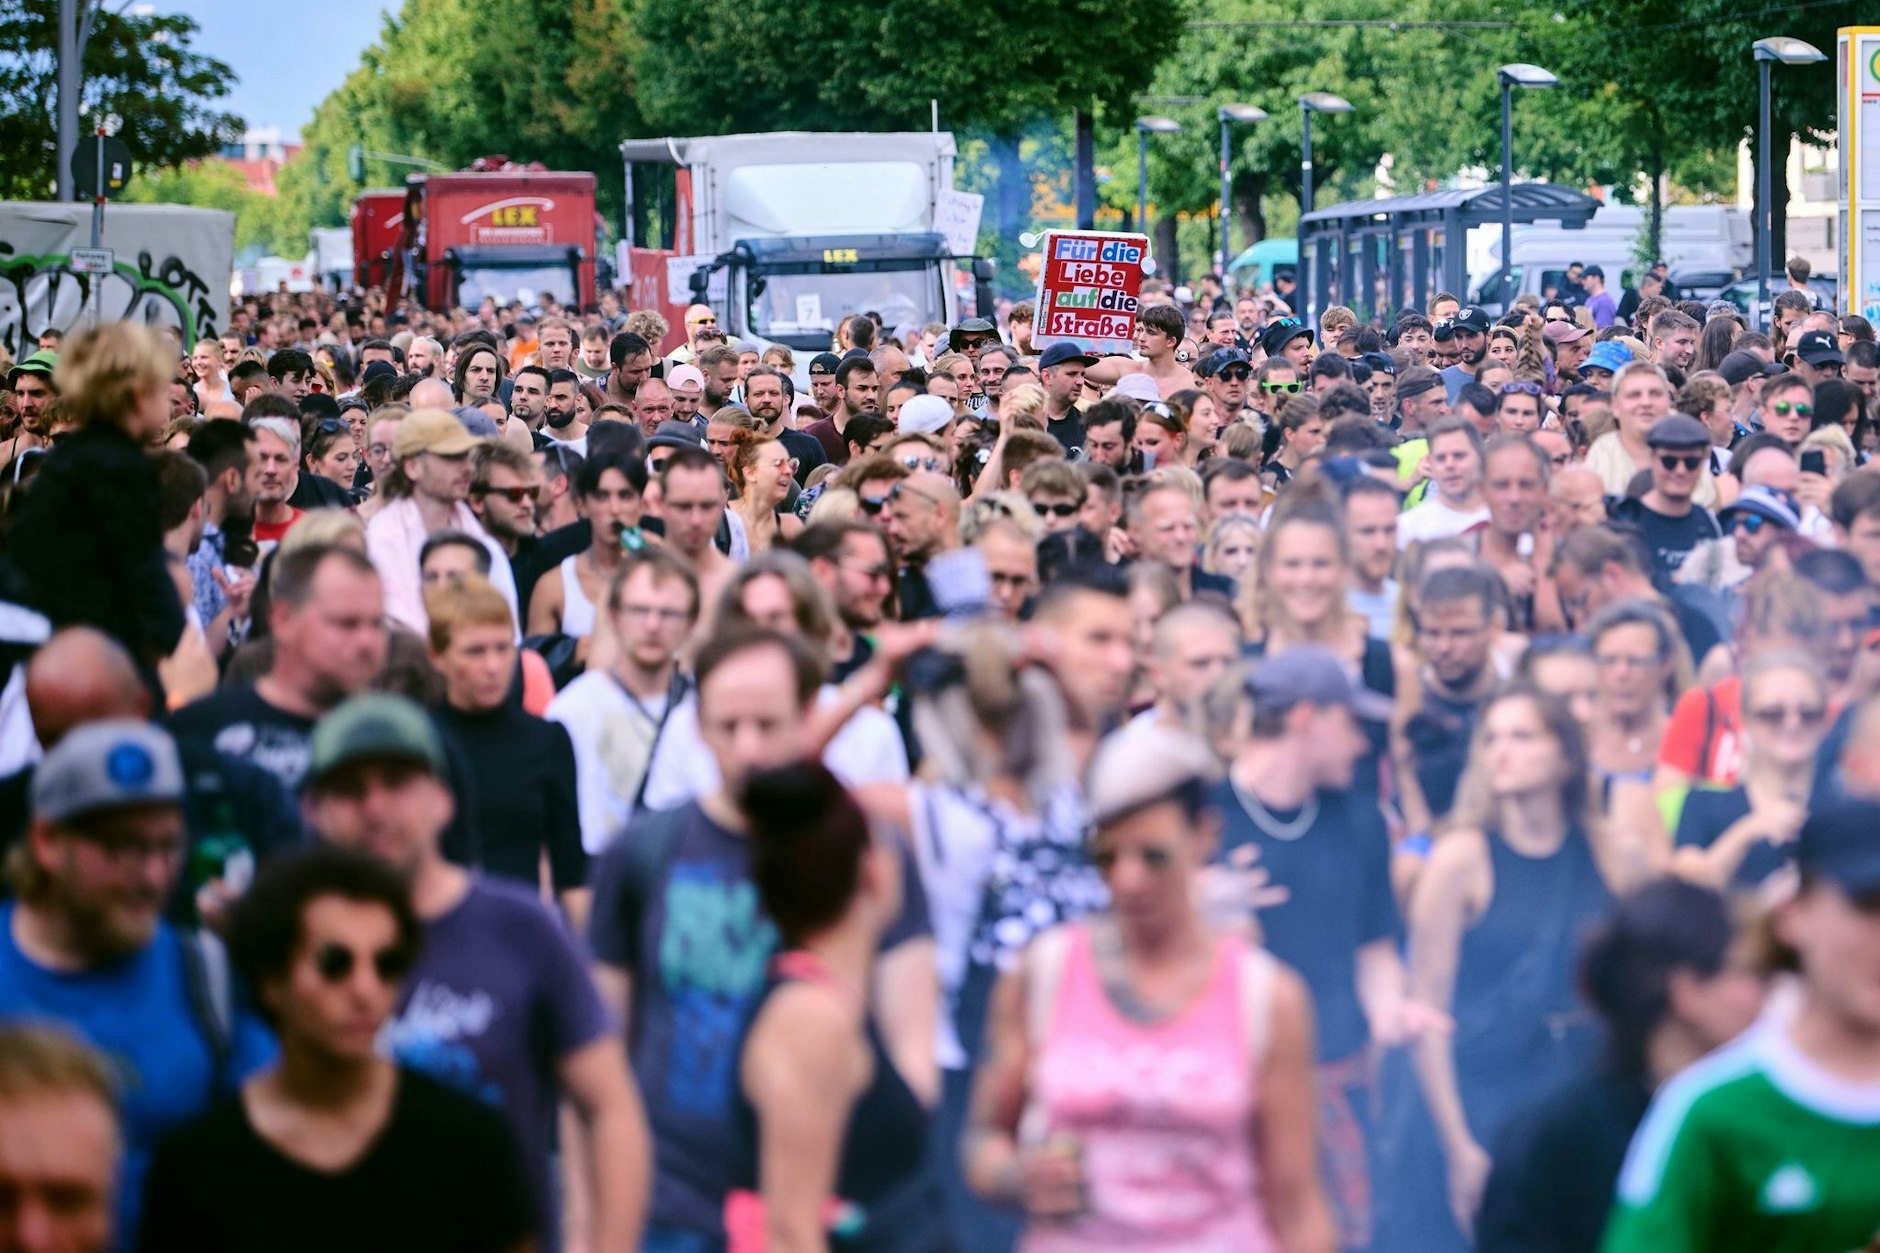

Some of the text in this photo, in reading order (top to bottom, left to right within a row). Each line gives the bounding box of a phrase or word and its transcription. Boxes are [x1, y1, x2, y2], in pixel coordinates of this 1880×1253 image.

[492, 207, 537, 226] LEX
[823, 249, 859, 263] LEX
[1056, 239, 1139, 262] Für die
[1059, 262, 1124, 285] Liebe
[1057, 289, 1097, 307] auf
[1101, 291, 1137, 311] die
[1053, 314, 1128, 336] Straße
